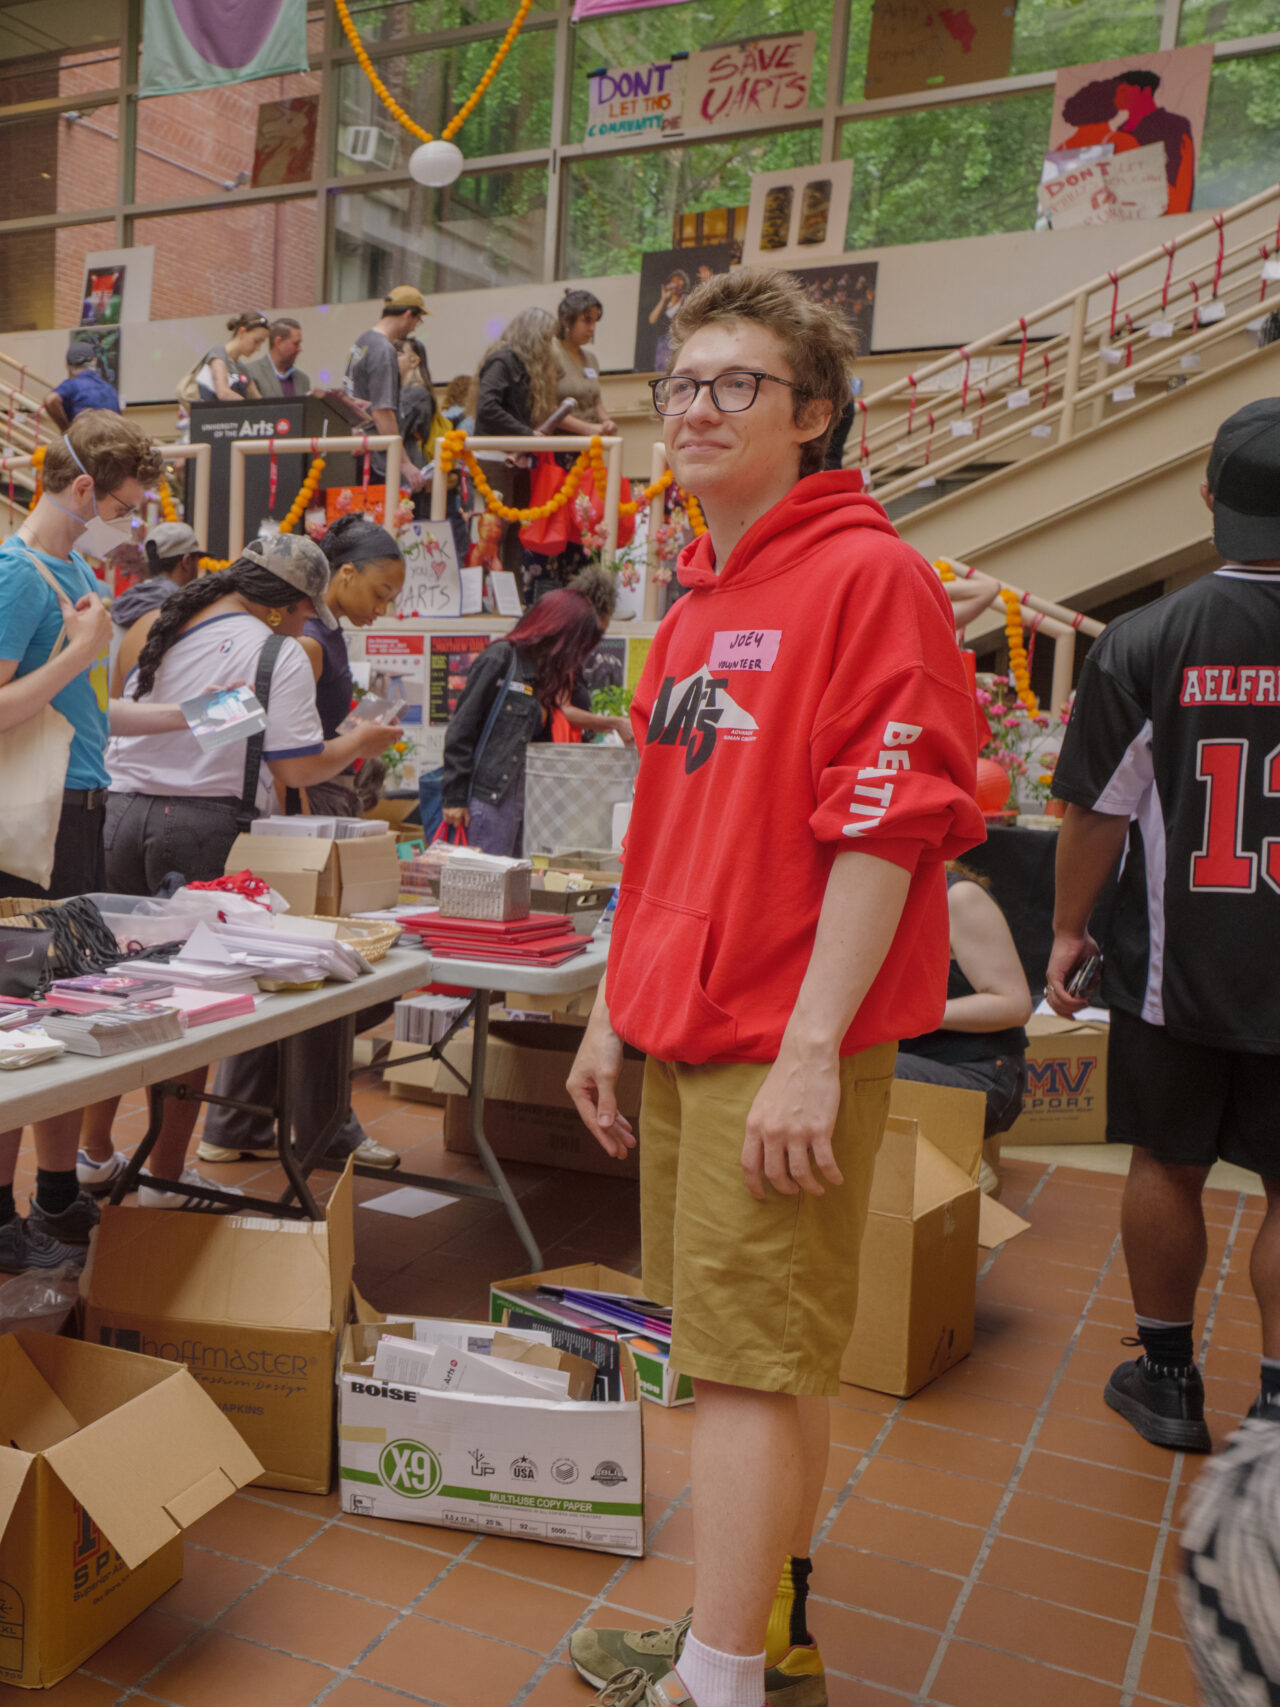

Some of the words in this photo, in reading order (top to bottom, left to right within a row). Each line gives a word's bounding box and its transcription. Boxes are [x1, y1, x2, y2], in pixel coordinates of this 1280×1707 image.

[708, 43, 803, 75] SAVE
[597, 63, 674, 105] DON'T
[608, 98, 638, 119] LET
[643, 92, 673, 114] THIS
[587, 113, 664, 137] COMMUNITY
[660, 115, 683, 132] DIE
[238, 420, 274, 438] Arts
[729, 630, 765, 650] JOEY
[718, 658, 763, 670] VOLUNTEER
[443, 1367, 457, 1386] Arts
[513, 1467, 536, 1481] USA
[489, 1491, 536, 1508] MULTI-USE
[536, 1497, 562, 1511] COPY
[562, 1500, 593, 1513] PAPER
